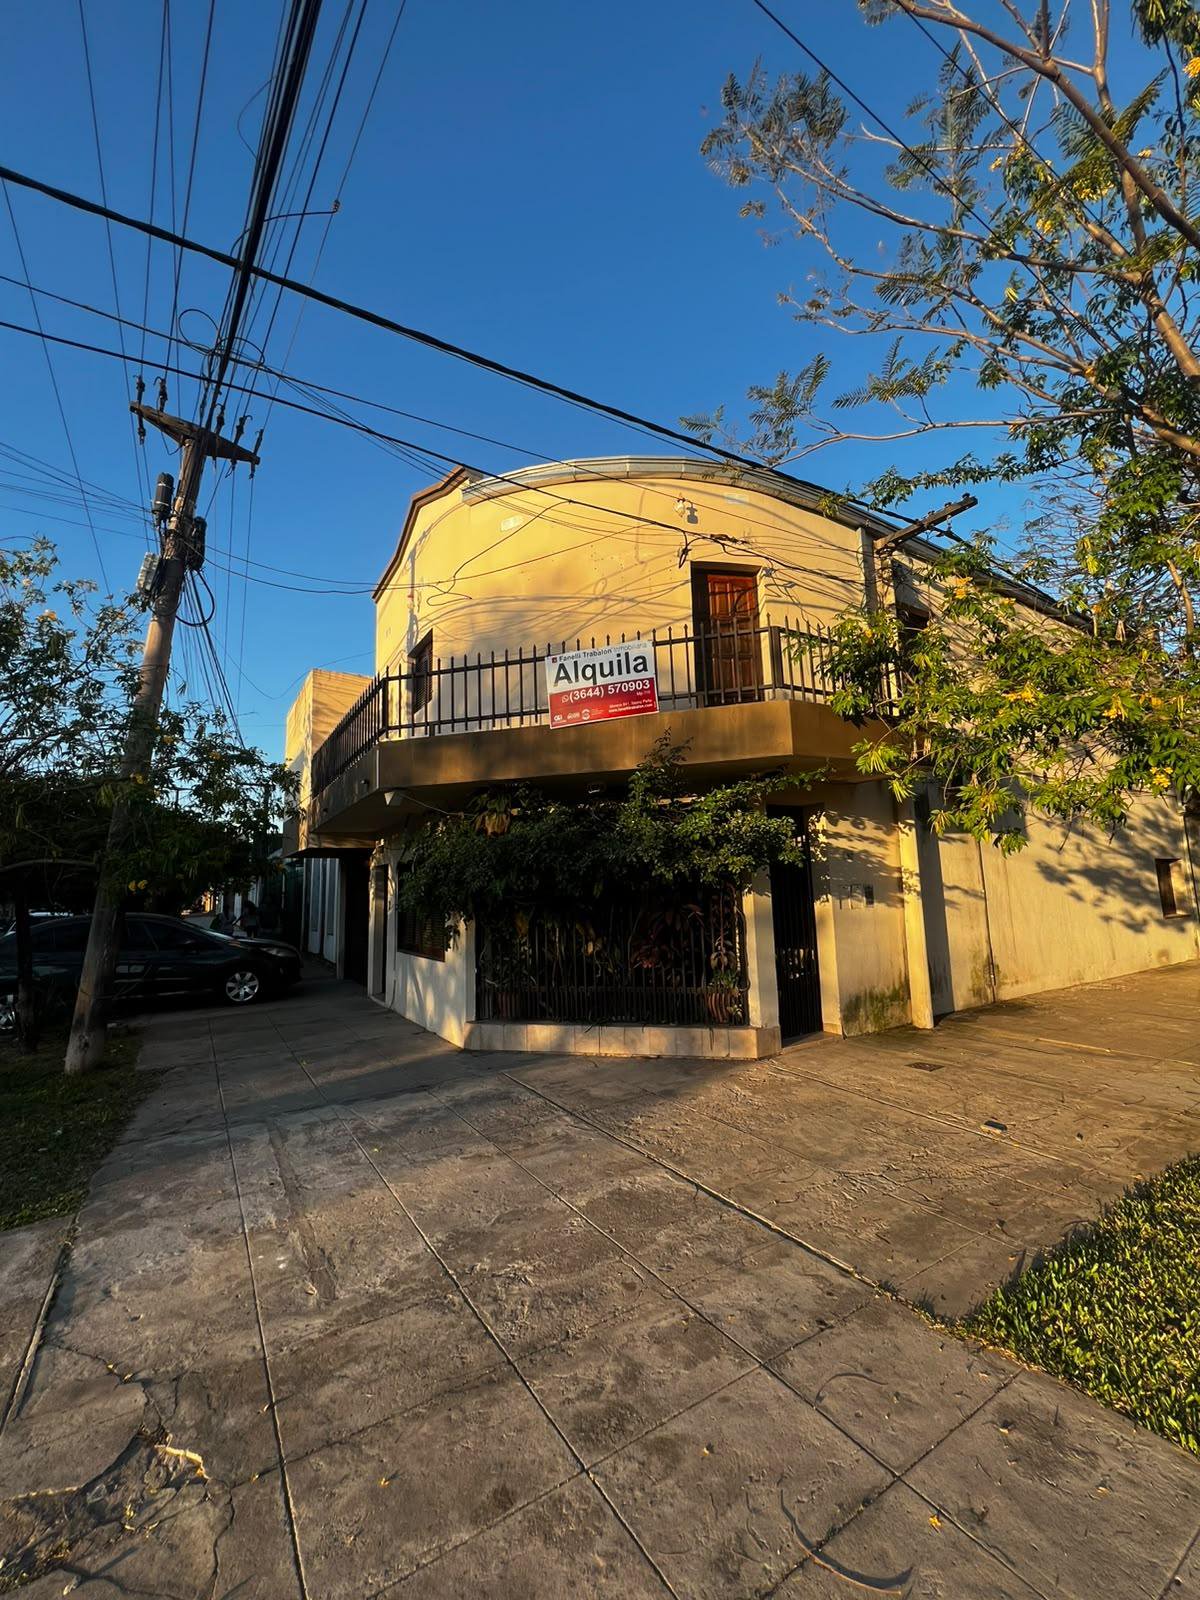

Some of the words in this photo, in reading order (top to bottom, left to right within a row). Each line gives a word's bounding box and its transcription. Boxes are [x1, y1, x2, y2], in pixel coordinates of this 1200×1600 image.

[553, 651, 649, 687] Alquila
[559, 653, 581, 662] Fanelli
[569, 686, 605, 703] (3644)
[608, 679, 650, 694] 570903
